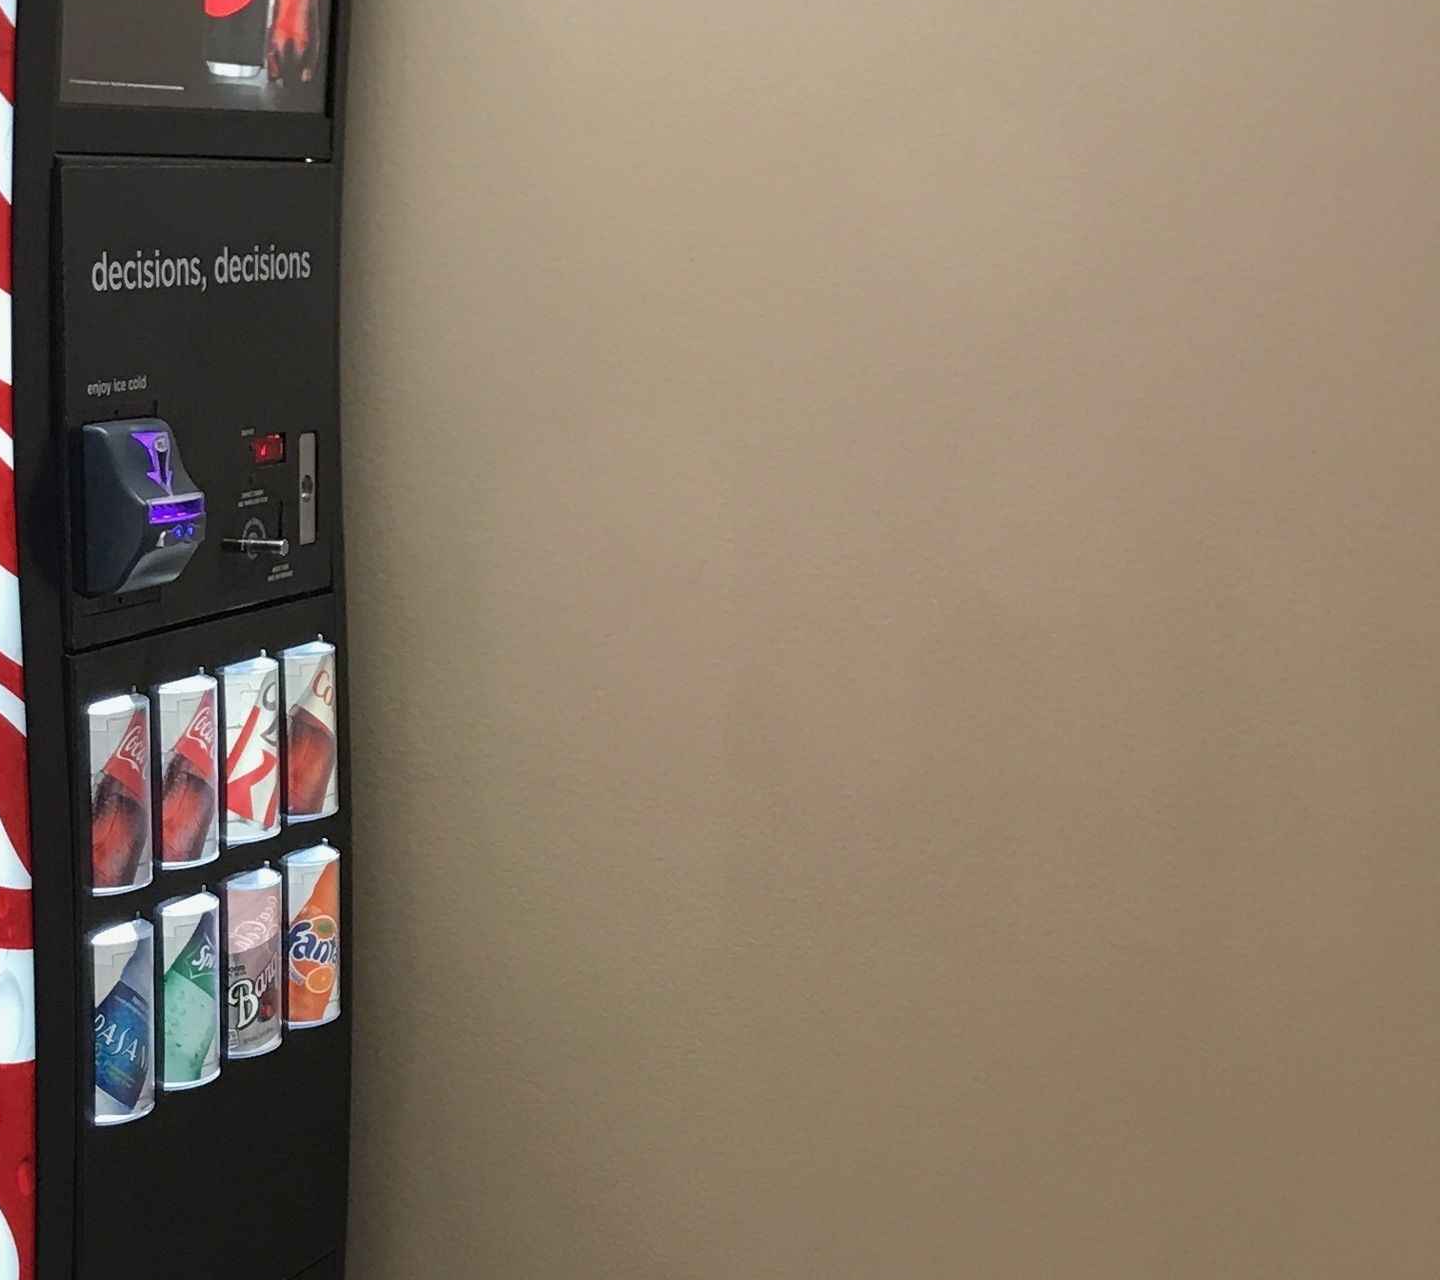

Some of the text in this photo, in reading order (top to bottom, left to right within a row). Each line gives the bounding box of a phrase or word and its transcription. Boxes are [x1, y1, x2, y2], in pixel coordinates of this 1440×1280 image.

[91, 244, 311, 292] decisions, decisions
[87, 375, 148, 398] enjoy ice cold
